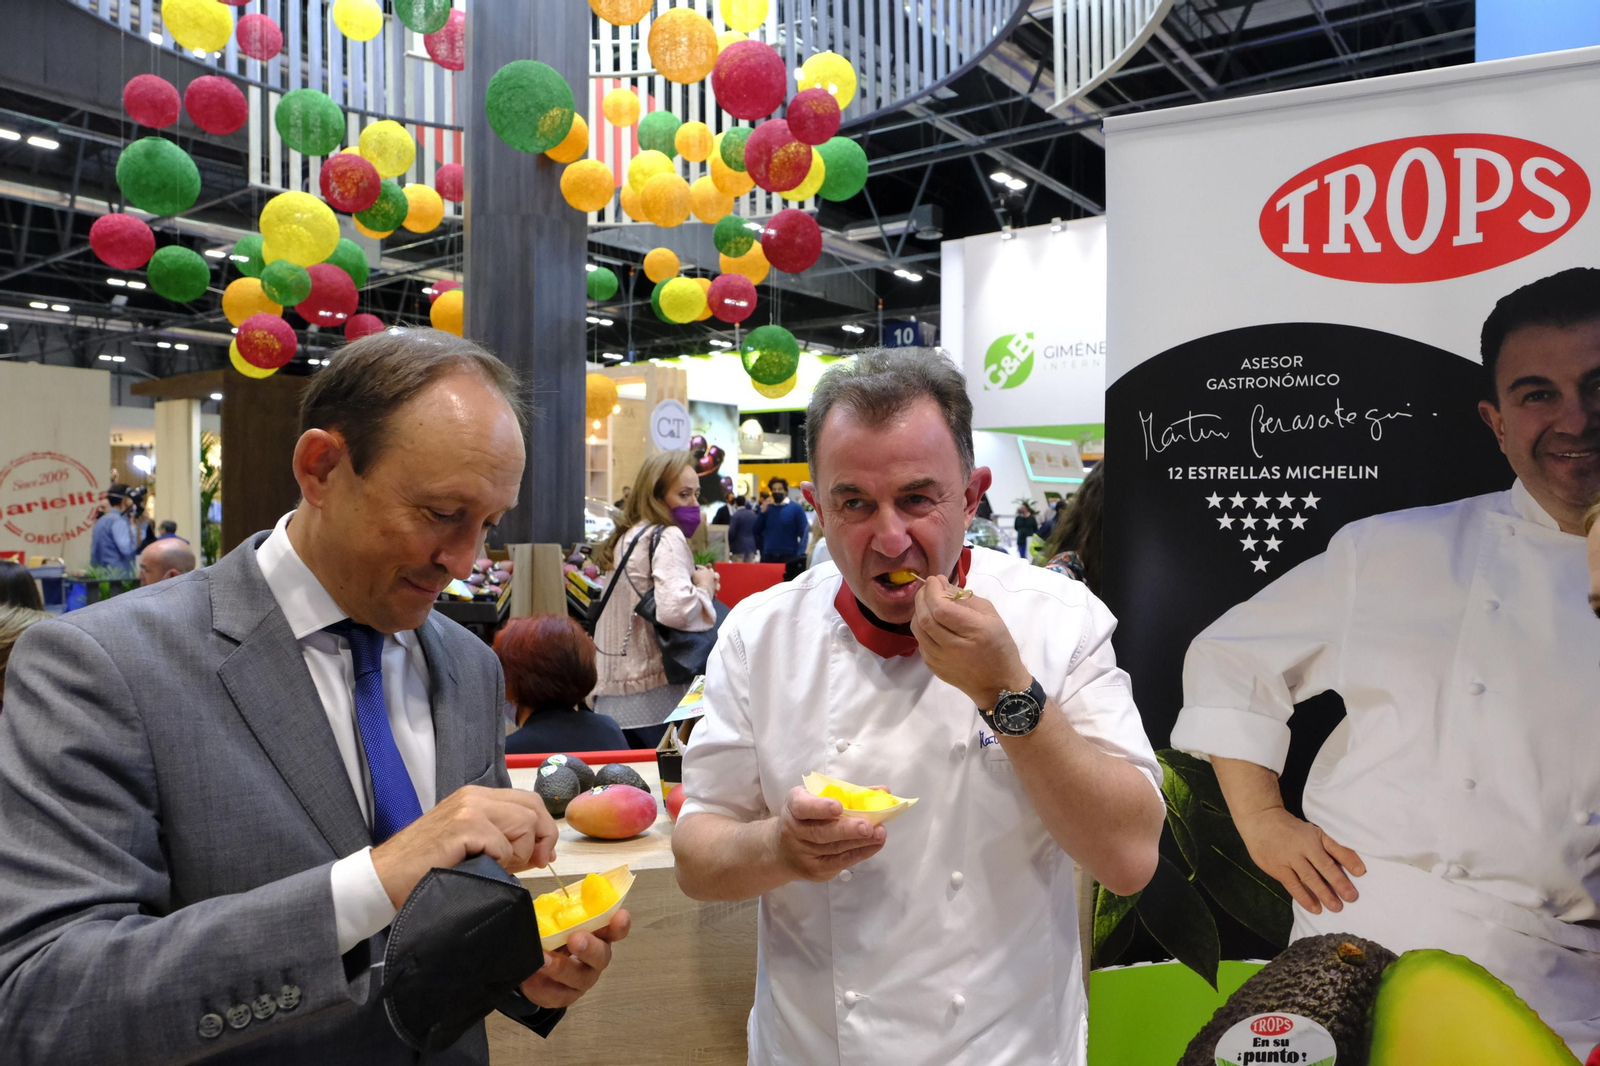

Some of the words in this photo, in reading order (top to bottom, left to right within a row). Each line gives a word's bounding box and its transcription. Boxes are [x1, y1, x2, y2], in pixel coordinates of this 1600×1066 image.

[1276, 147, 1571, 255] TROPS
[893, 327, 915, 346] 10
[1240, 355, 1304, 370] ASESOR
[1206, 372, 1341, 391] GASTRONÓMICO
[1168, 467, 1183, 480] 12
[1188, 465, 1281, 480] ESTRELLAS
[1285, 465, 1379, 480] MICHELIN
[0, 490, 108, 519] arielit
[1253, 1017, 1291, 1032] TROPS
[1253, 1037, 1269, 1047] En
[1273, 1038, 1289, 1047] su
